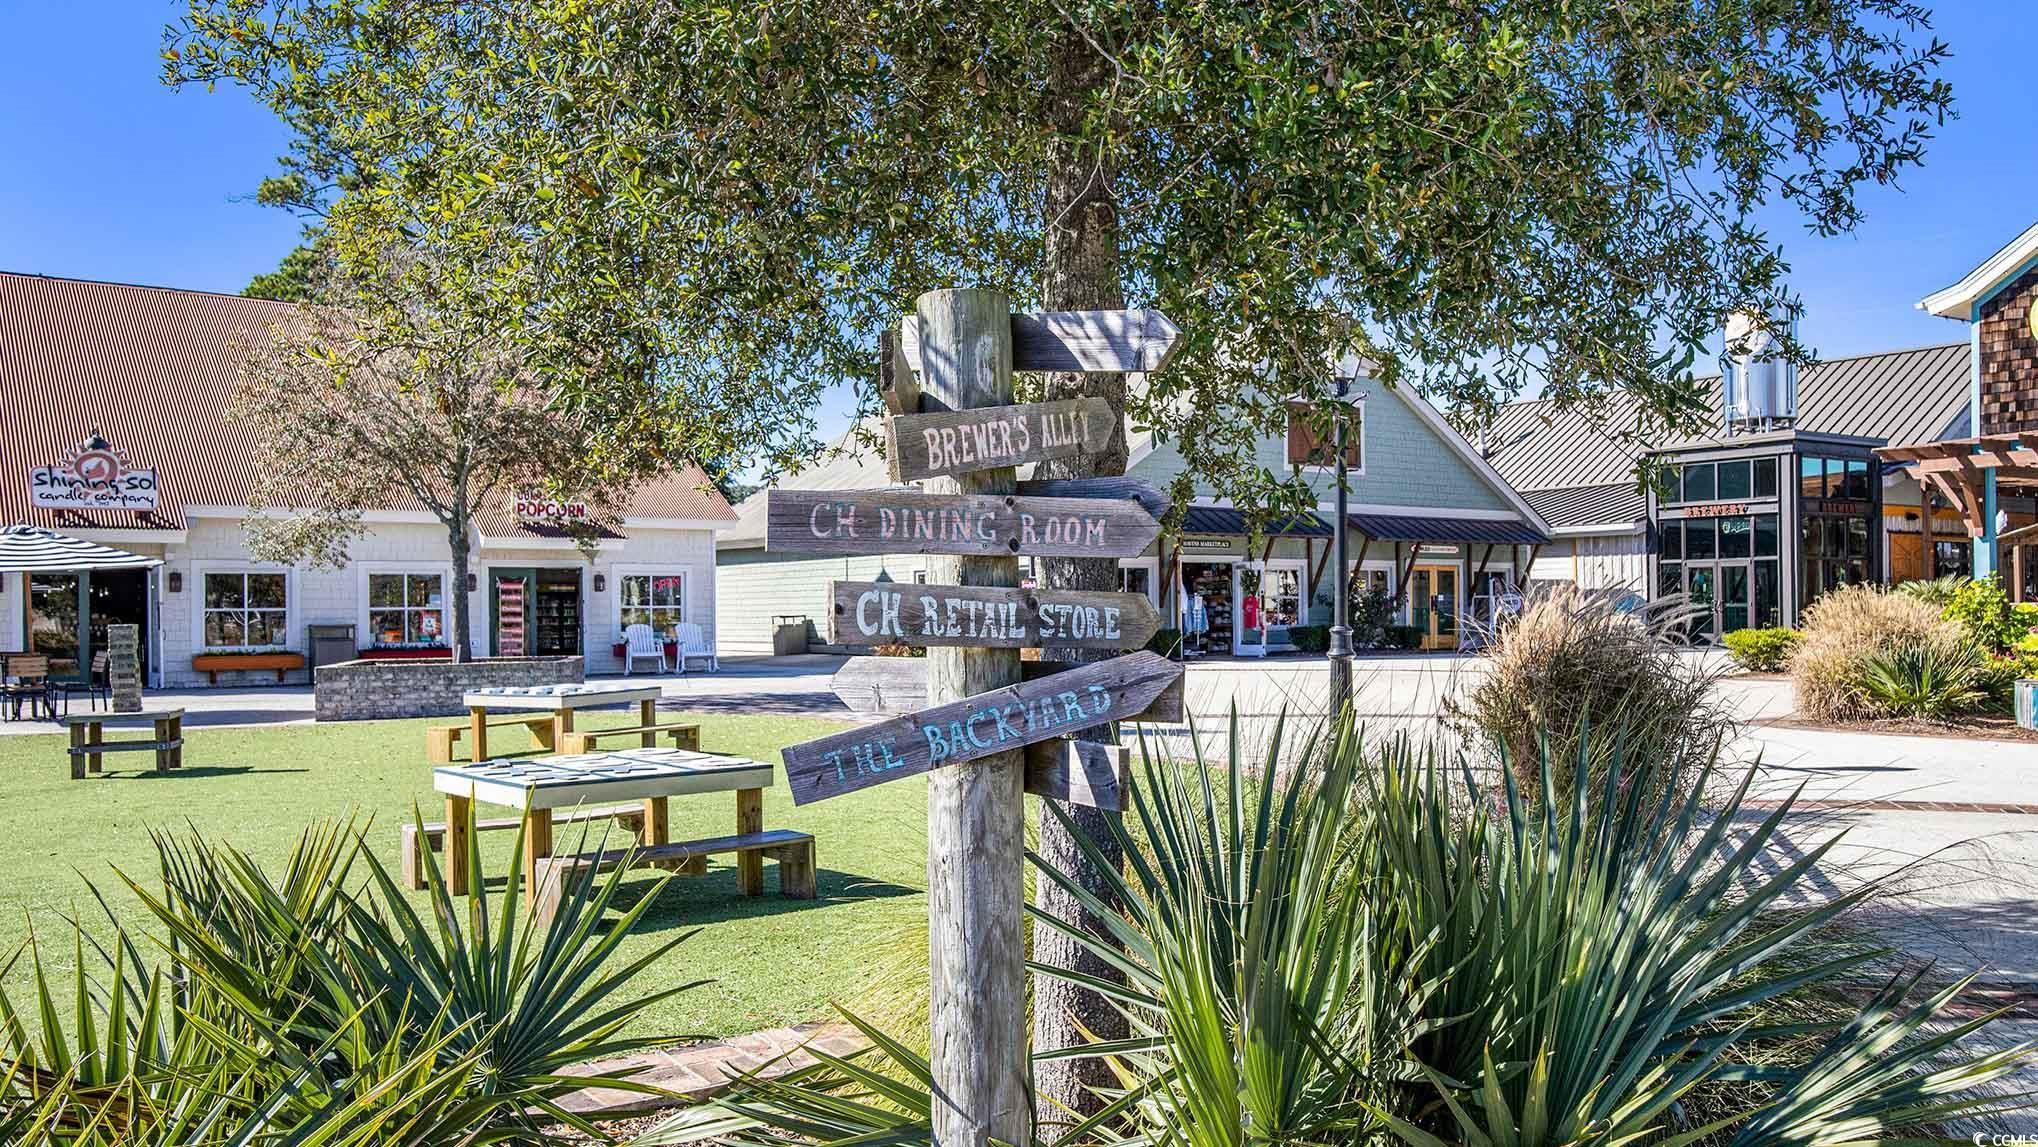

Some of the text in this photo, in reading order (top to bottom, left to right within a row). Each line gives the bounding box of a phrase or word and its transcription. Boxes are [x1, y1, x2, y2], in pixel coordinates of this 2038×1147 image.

[922, 415, 1031, 471] BREWER'S
[34, 464, 157, 494] shining sol
[39, 488, 84, 502] candle
[94, 493, 155, 508] company
[516, 502, 585, 517] POPCORN
[1684, 503, 1746, 518] BREWERY
[809, 502, 1106, 546] CH DINING ROOM
[855, 589, 1121, 640] CH RETAIL STORE
[821, 684, 1112, 785] THE BACKYARD
